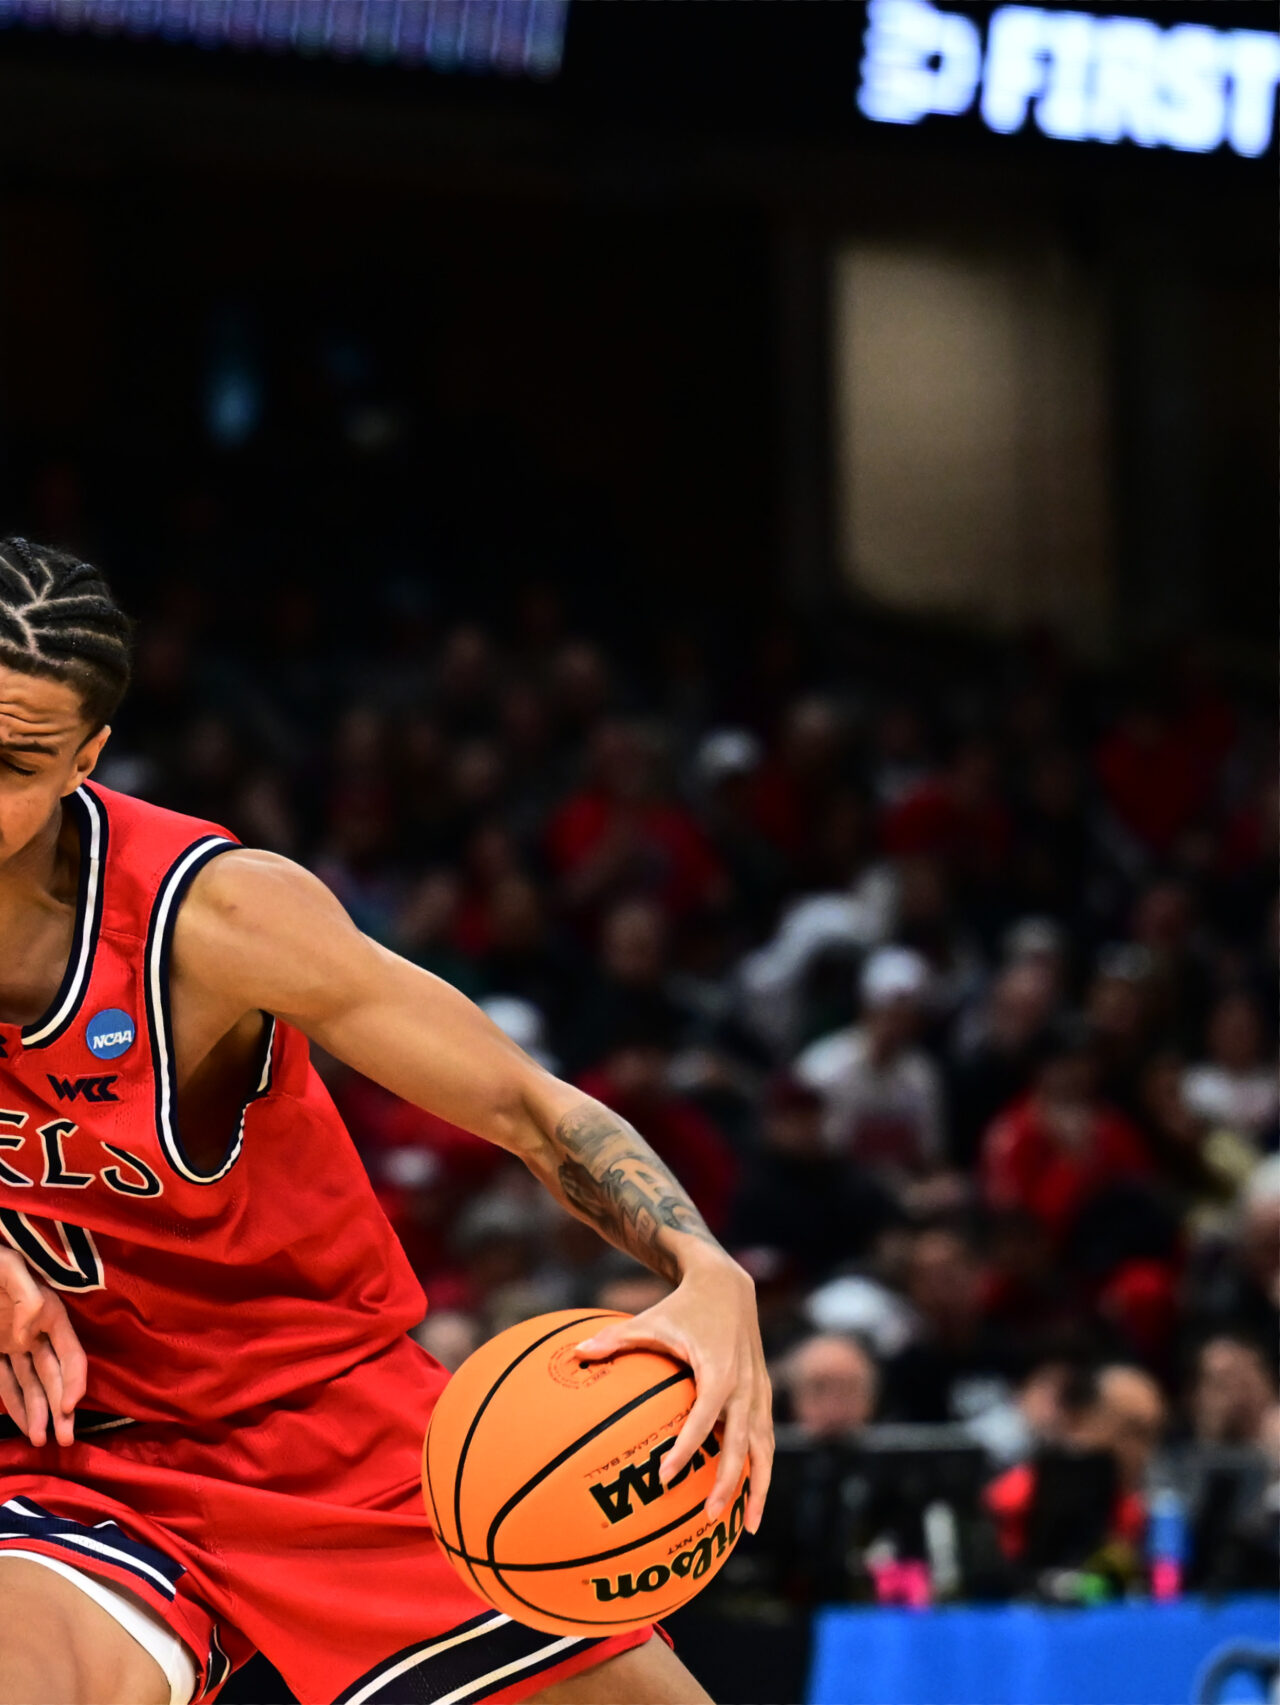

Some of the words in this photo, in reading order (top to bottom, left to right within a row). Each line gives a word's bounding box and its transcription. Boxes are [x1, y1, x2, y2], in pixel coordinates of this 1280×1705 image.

[978, 4, 1280, 158] FIRST
[93, 1030, 132, 1050] NCAA
[46, 1073, 120, 1102] WCC
[584, 1457, 620, 1478] BALL
[696, 1518, 718, 1537] VO
[668, 1537, 692, 1556] NXT
